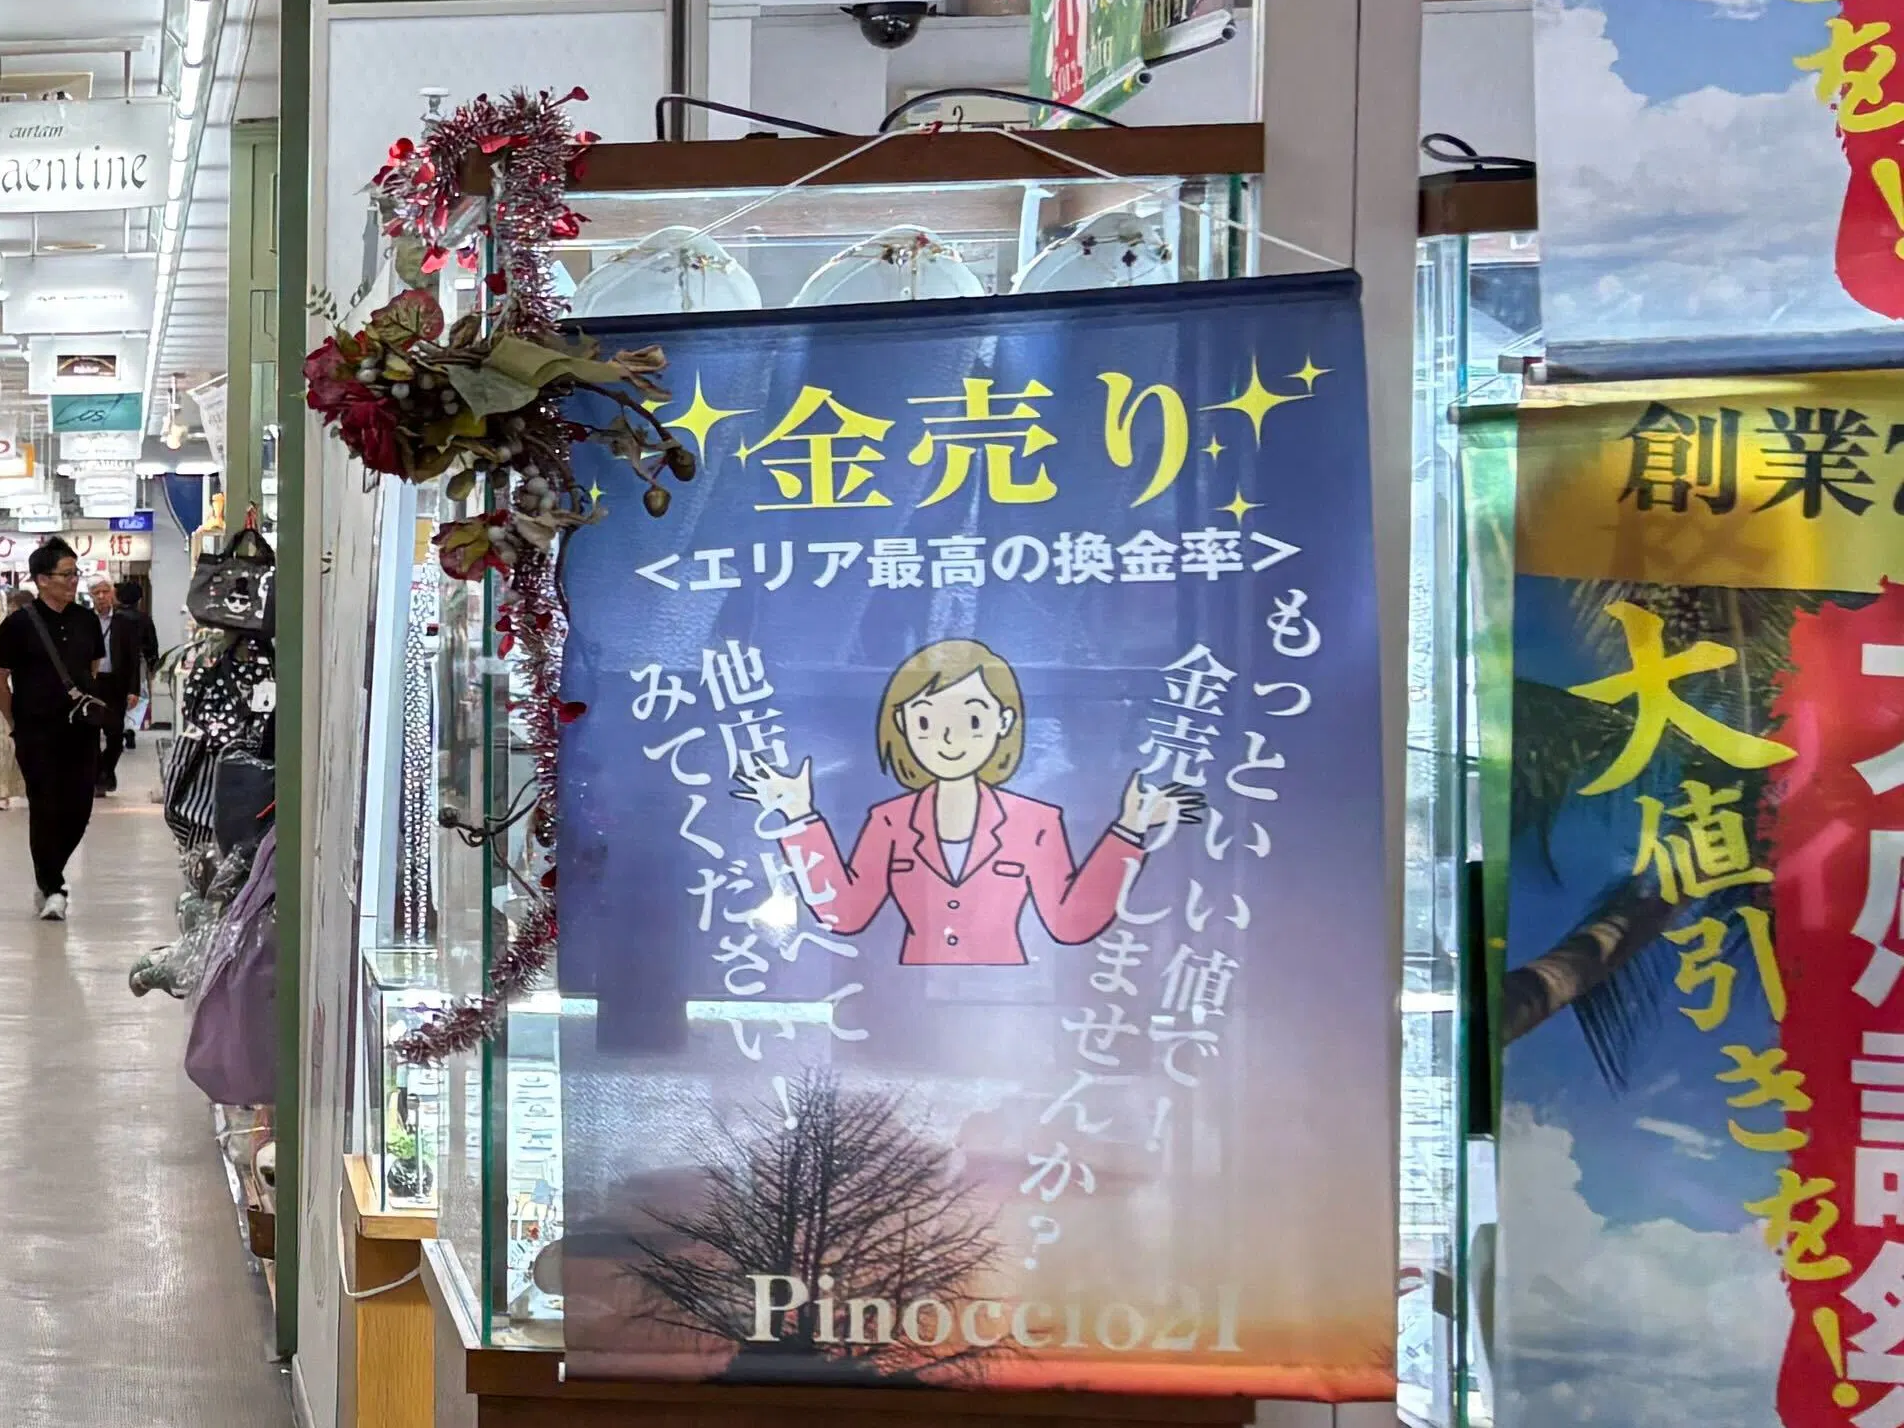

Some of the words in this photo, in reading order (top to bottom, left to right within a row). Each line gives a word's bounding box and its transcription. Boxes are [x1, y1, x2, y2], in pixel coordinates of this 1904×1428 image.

[747, 371, 1189, 512] 金売り
[1617, 401, 1904, 519] 創業
[1568, 601, 1861, 1408] 大値引きを！
[745, 1272, 1245, 1354] Pinoccio21
